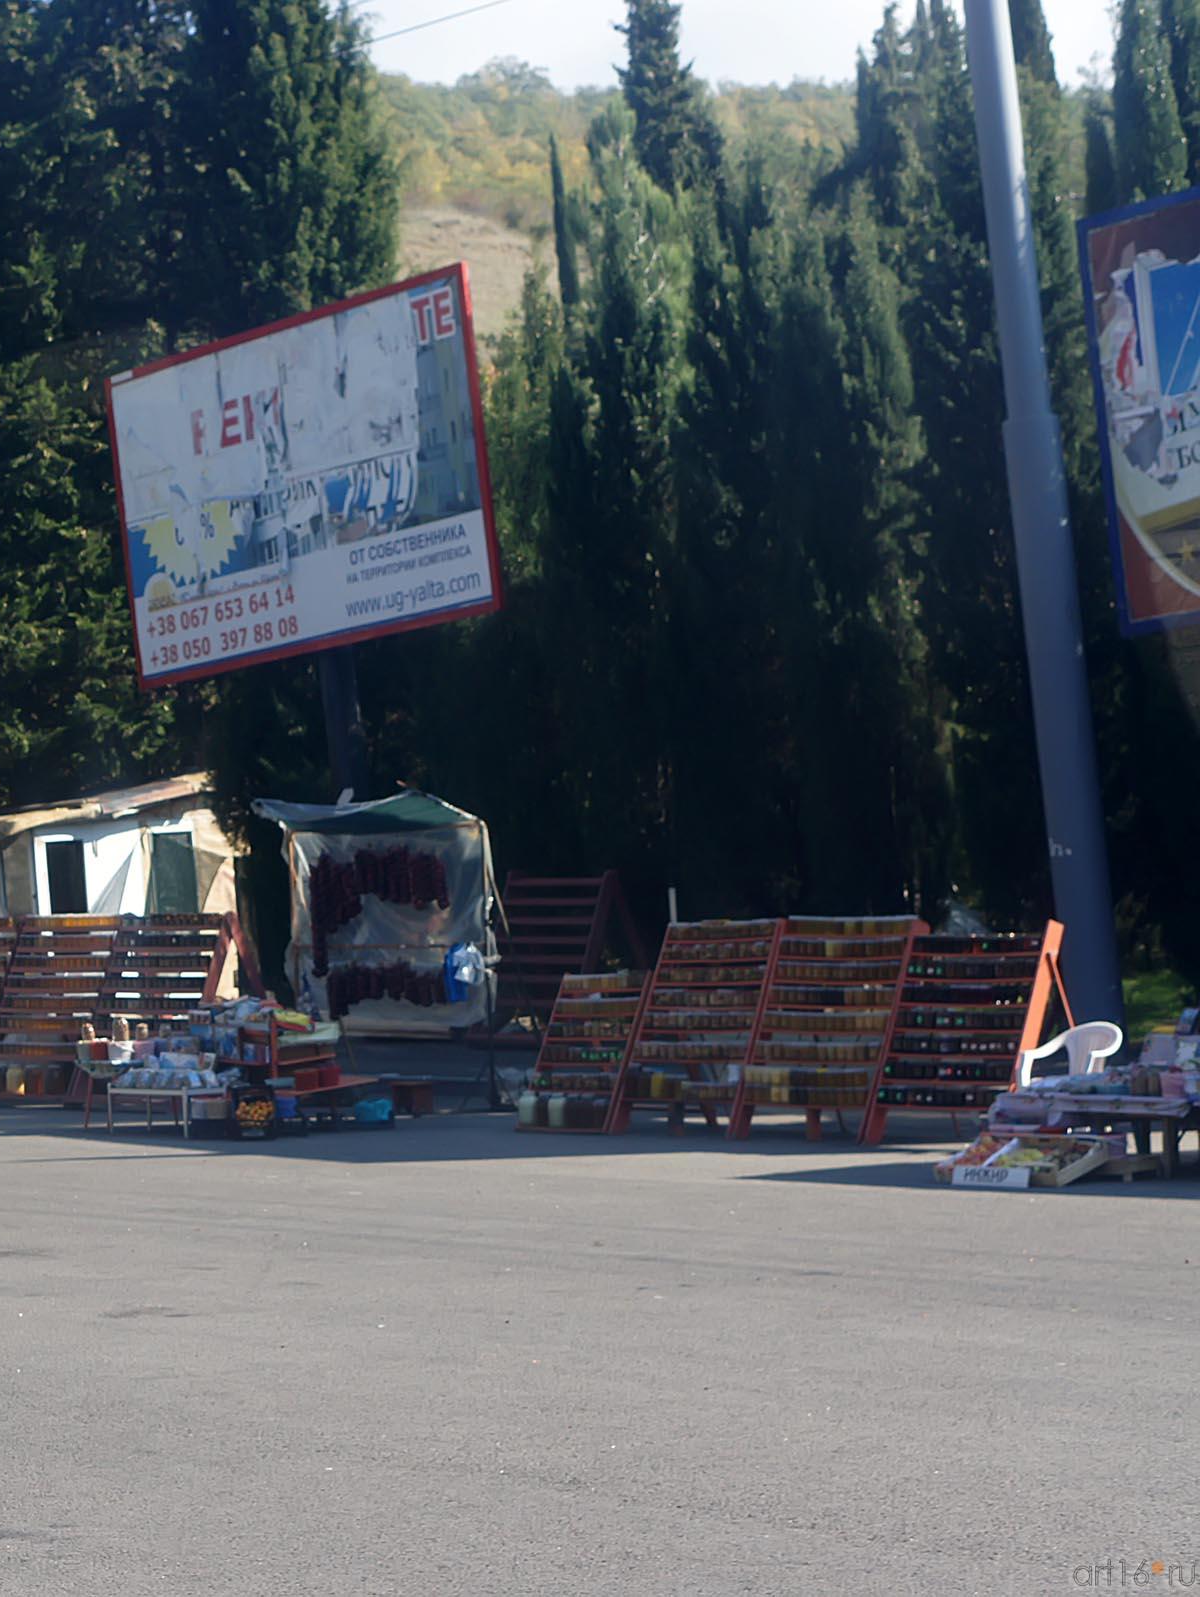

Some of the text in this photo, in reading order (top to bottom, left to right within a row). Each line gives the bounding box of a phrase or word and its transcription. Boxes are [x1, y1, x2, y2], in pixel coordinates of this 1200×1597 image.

[350, 523, 466, 565] ОТ СОБСТВЕННИКА
[147, 614, 176, 638] +38
[180, 606, 209, 630] 067
[214, 598, 244, 622] 653
[249, 591, 269, 614] 64
[275, 584, 294, 607] 14
[345, 572, 481, 617] www.ug-yalta.com
[151, 616, 298, 667] +38 050 397 88 08
